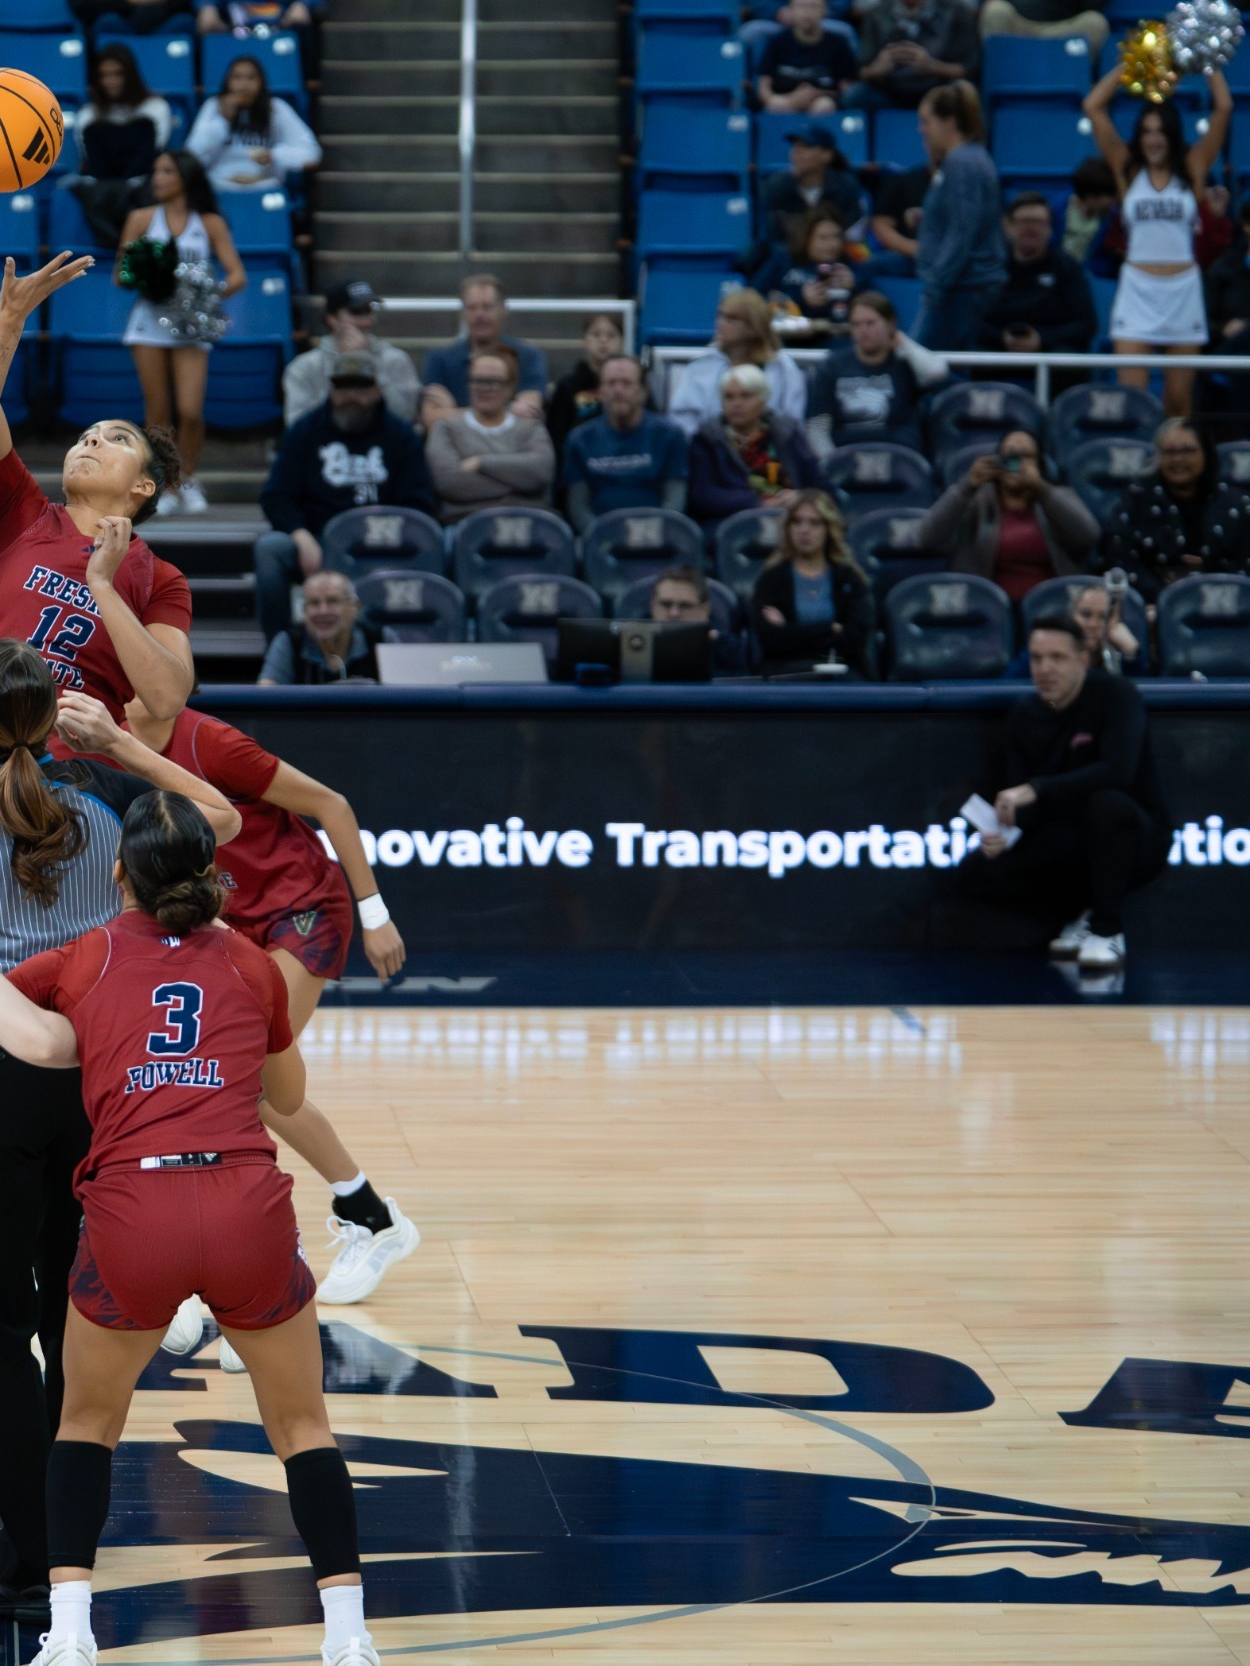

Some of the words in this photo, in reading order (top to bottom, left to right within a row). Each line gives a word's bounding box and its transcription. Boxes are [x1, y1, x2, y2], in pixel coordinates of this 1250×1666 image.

[26, 604, 97, 662] 12
[605, 816, 982, 877] Transportati
[146, 981, 204, 1057] 3
[124, 1057, 225, 1094] POWELL
